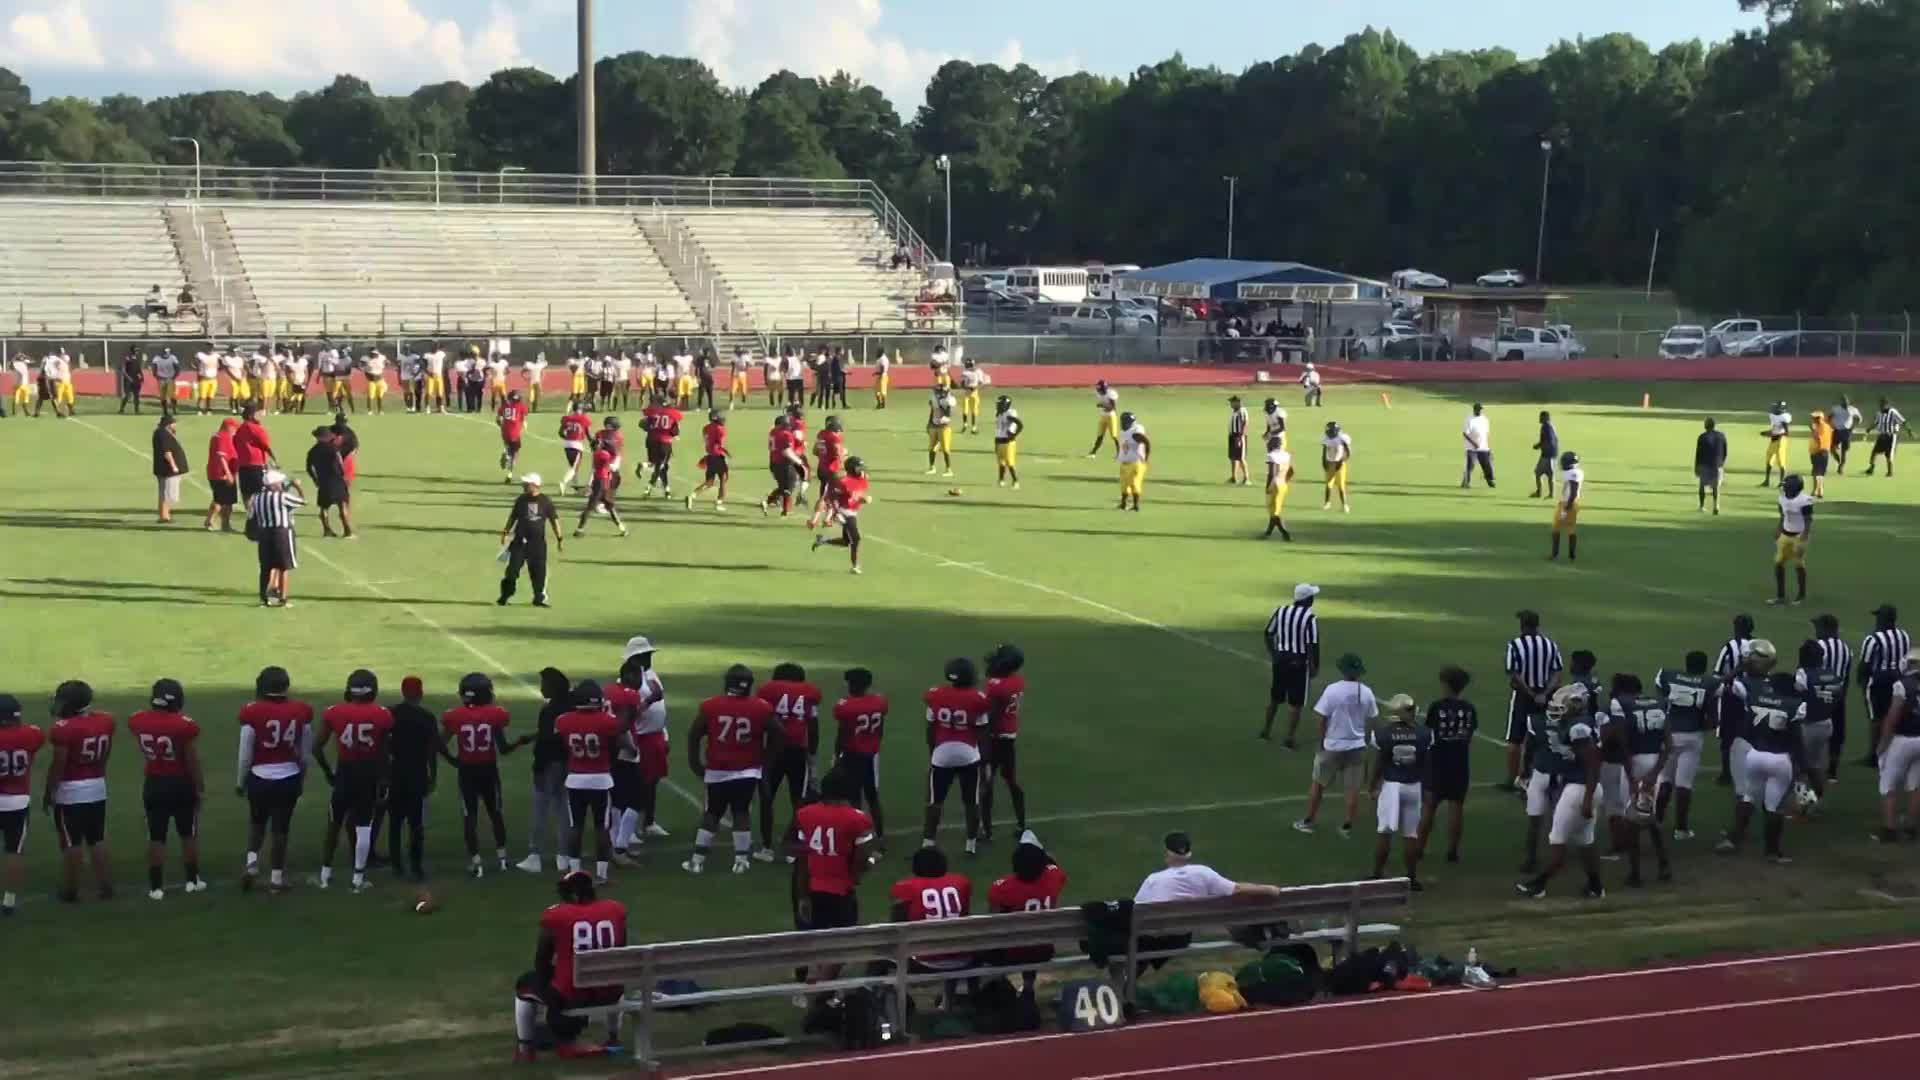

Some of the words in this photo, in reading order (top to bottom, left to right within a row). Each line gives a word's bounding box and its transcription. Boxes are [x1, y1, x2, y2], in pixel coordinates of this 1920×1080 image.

[775, 693, 805, 720] 44
[263, 719, 297, 750] 34
[339, 722, 375, 748] 45
[460, 723, 492, 753] 33
[717, 715, 752, 743] 72
[809, 825, 838, 857] 41
[921, 887, 961, 920] 90
[573, 920, 615, 951] 80
[1074, 984, 1119, 1027] 40
